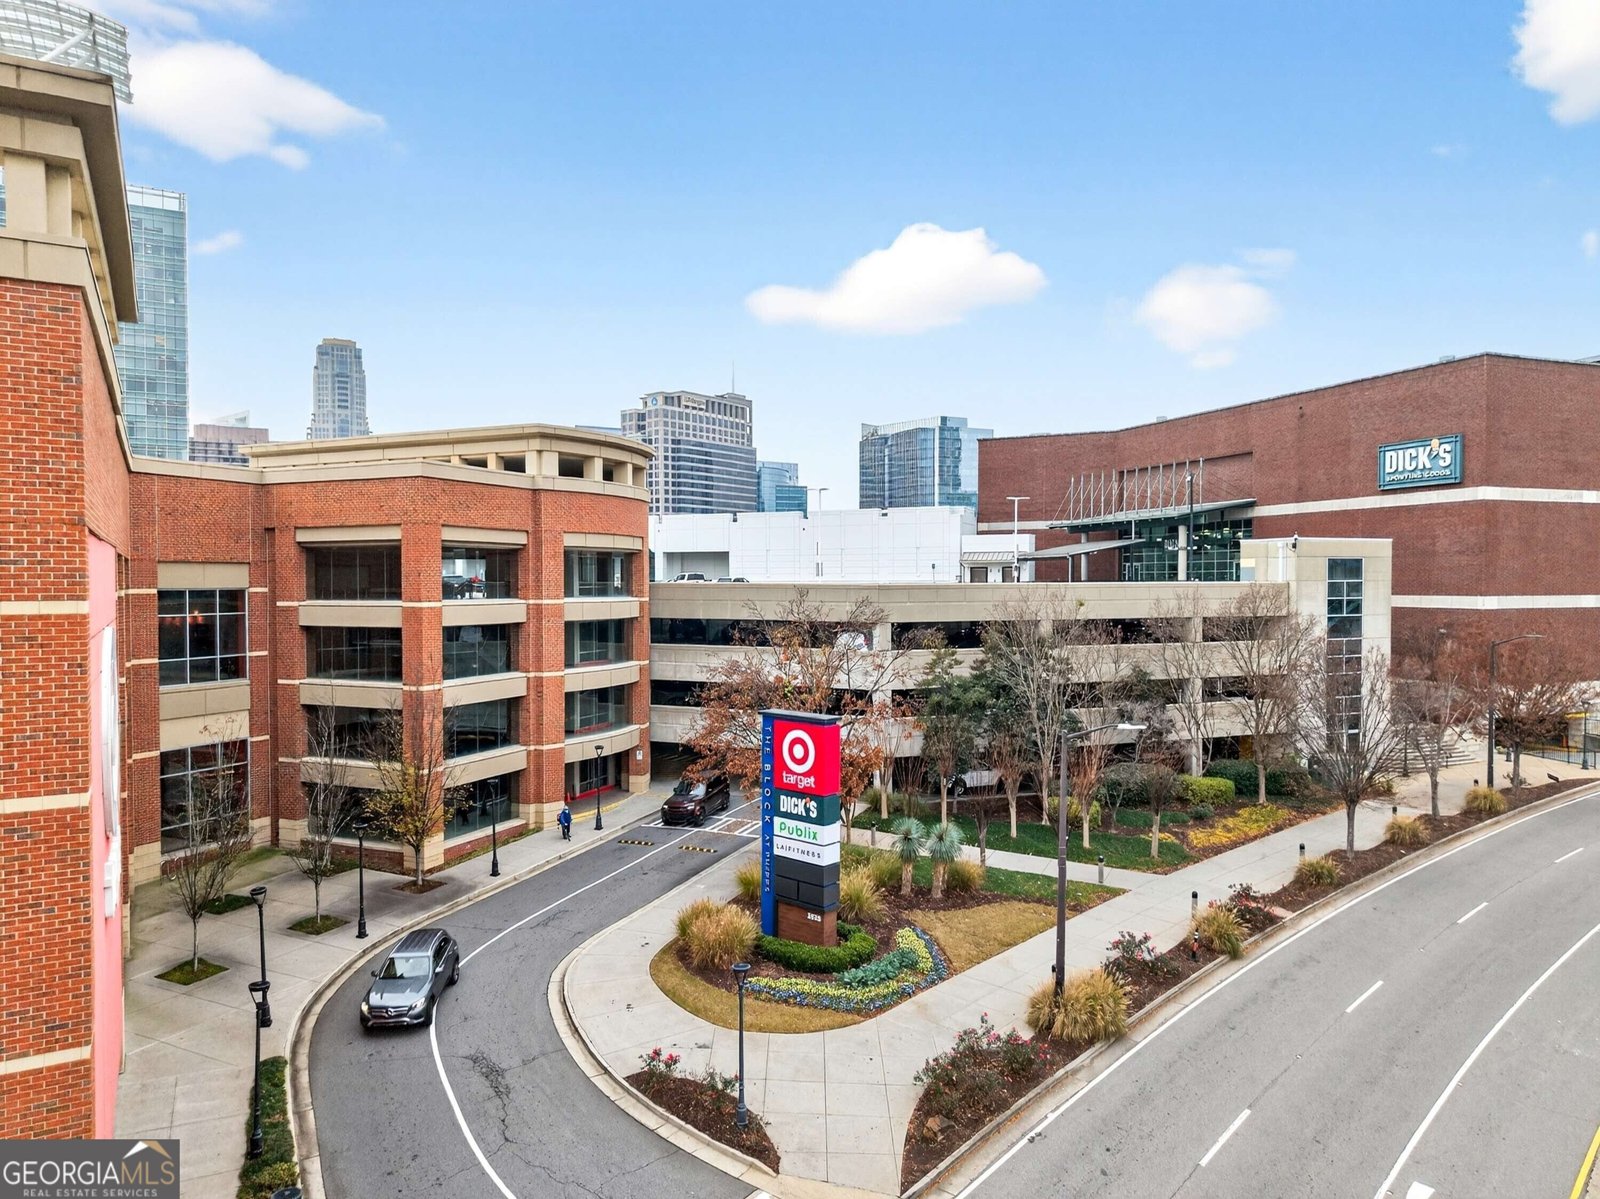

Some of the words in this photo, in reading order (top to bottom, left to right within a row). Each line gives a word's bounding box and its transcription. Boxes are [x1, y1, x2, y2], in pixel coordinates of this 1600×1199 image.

[1385, 443, 1452, 474] DICK'S
[764, 726, 772, 754] THE
[783, 770, 816, 789] target
[780, 795, 818, 818] DICK'S
[779, 821, 818, 841] Publix
